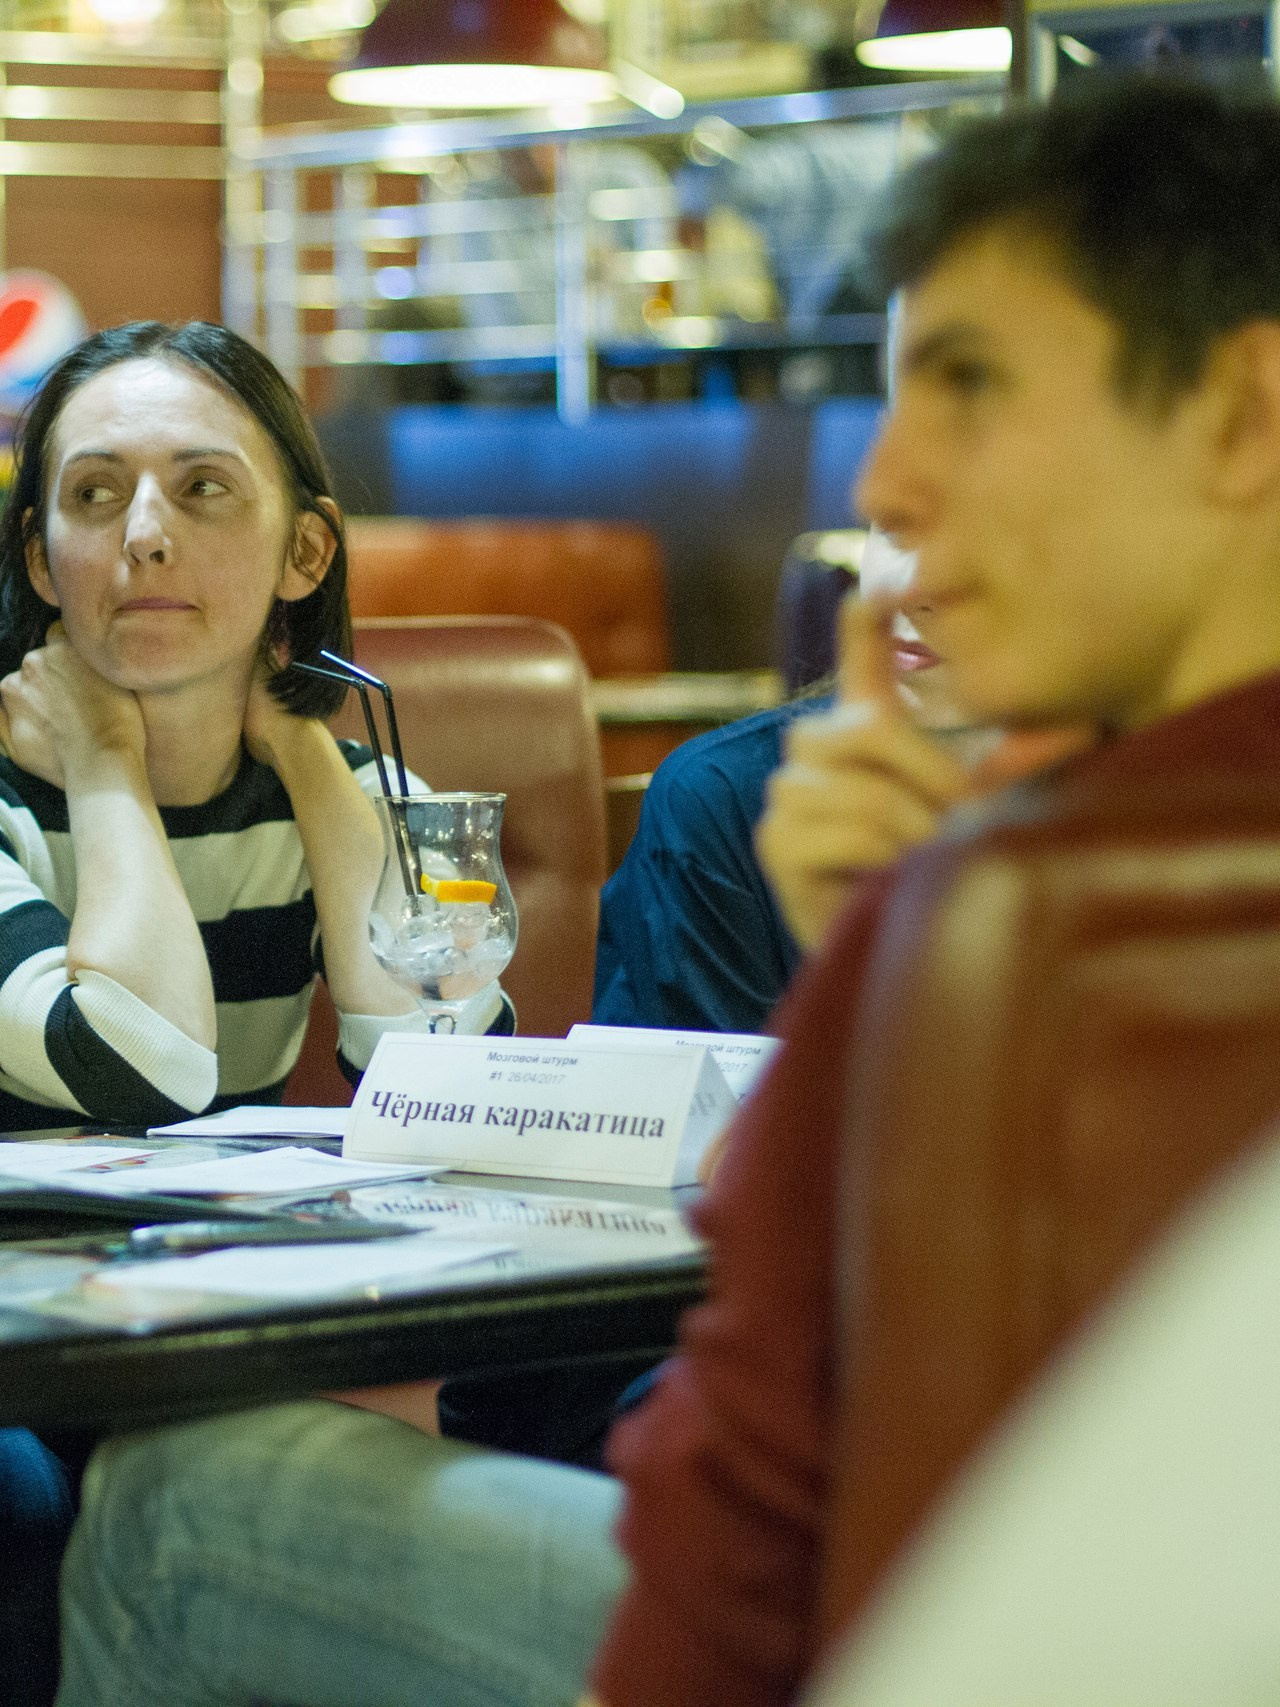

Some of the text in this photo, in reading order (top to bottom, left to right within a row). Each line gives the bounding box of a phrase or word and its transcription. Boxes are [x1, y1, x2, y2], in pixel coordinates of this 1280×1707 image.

[486, 1051, 579, 1067] Мозговой штурм
[507, 1070, 567, 1085] 26/04/2017
[371, 1090, 666, 1139] Чёрная каракатица
